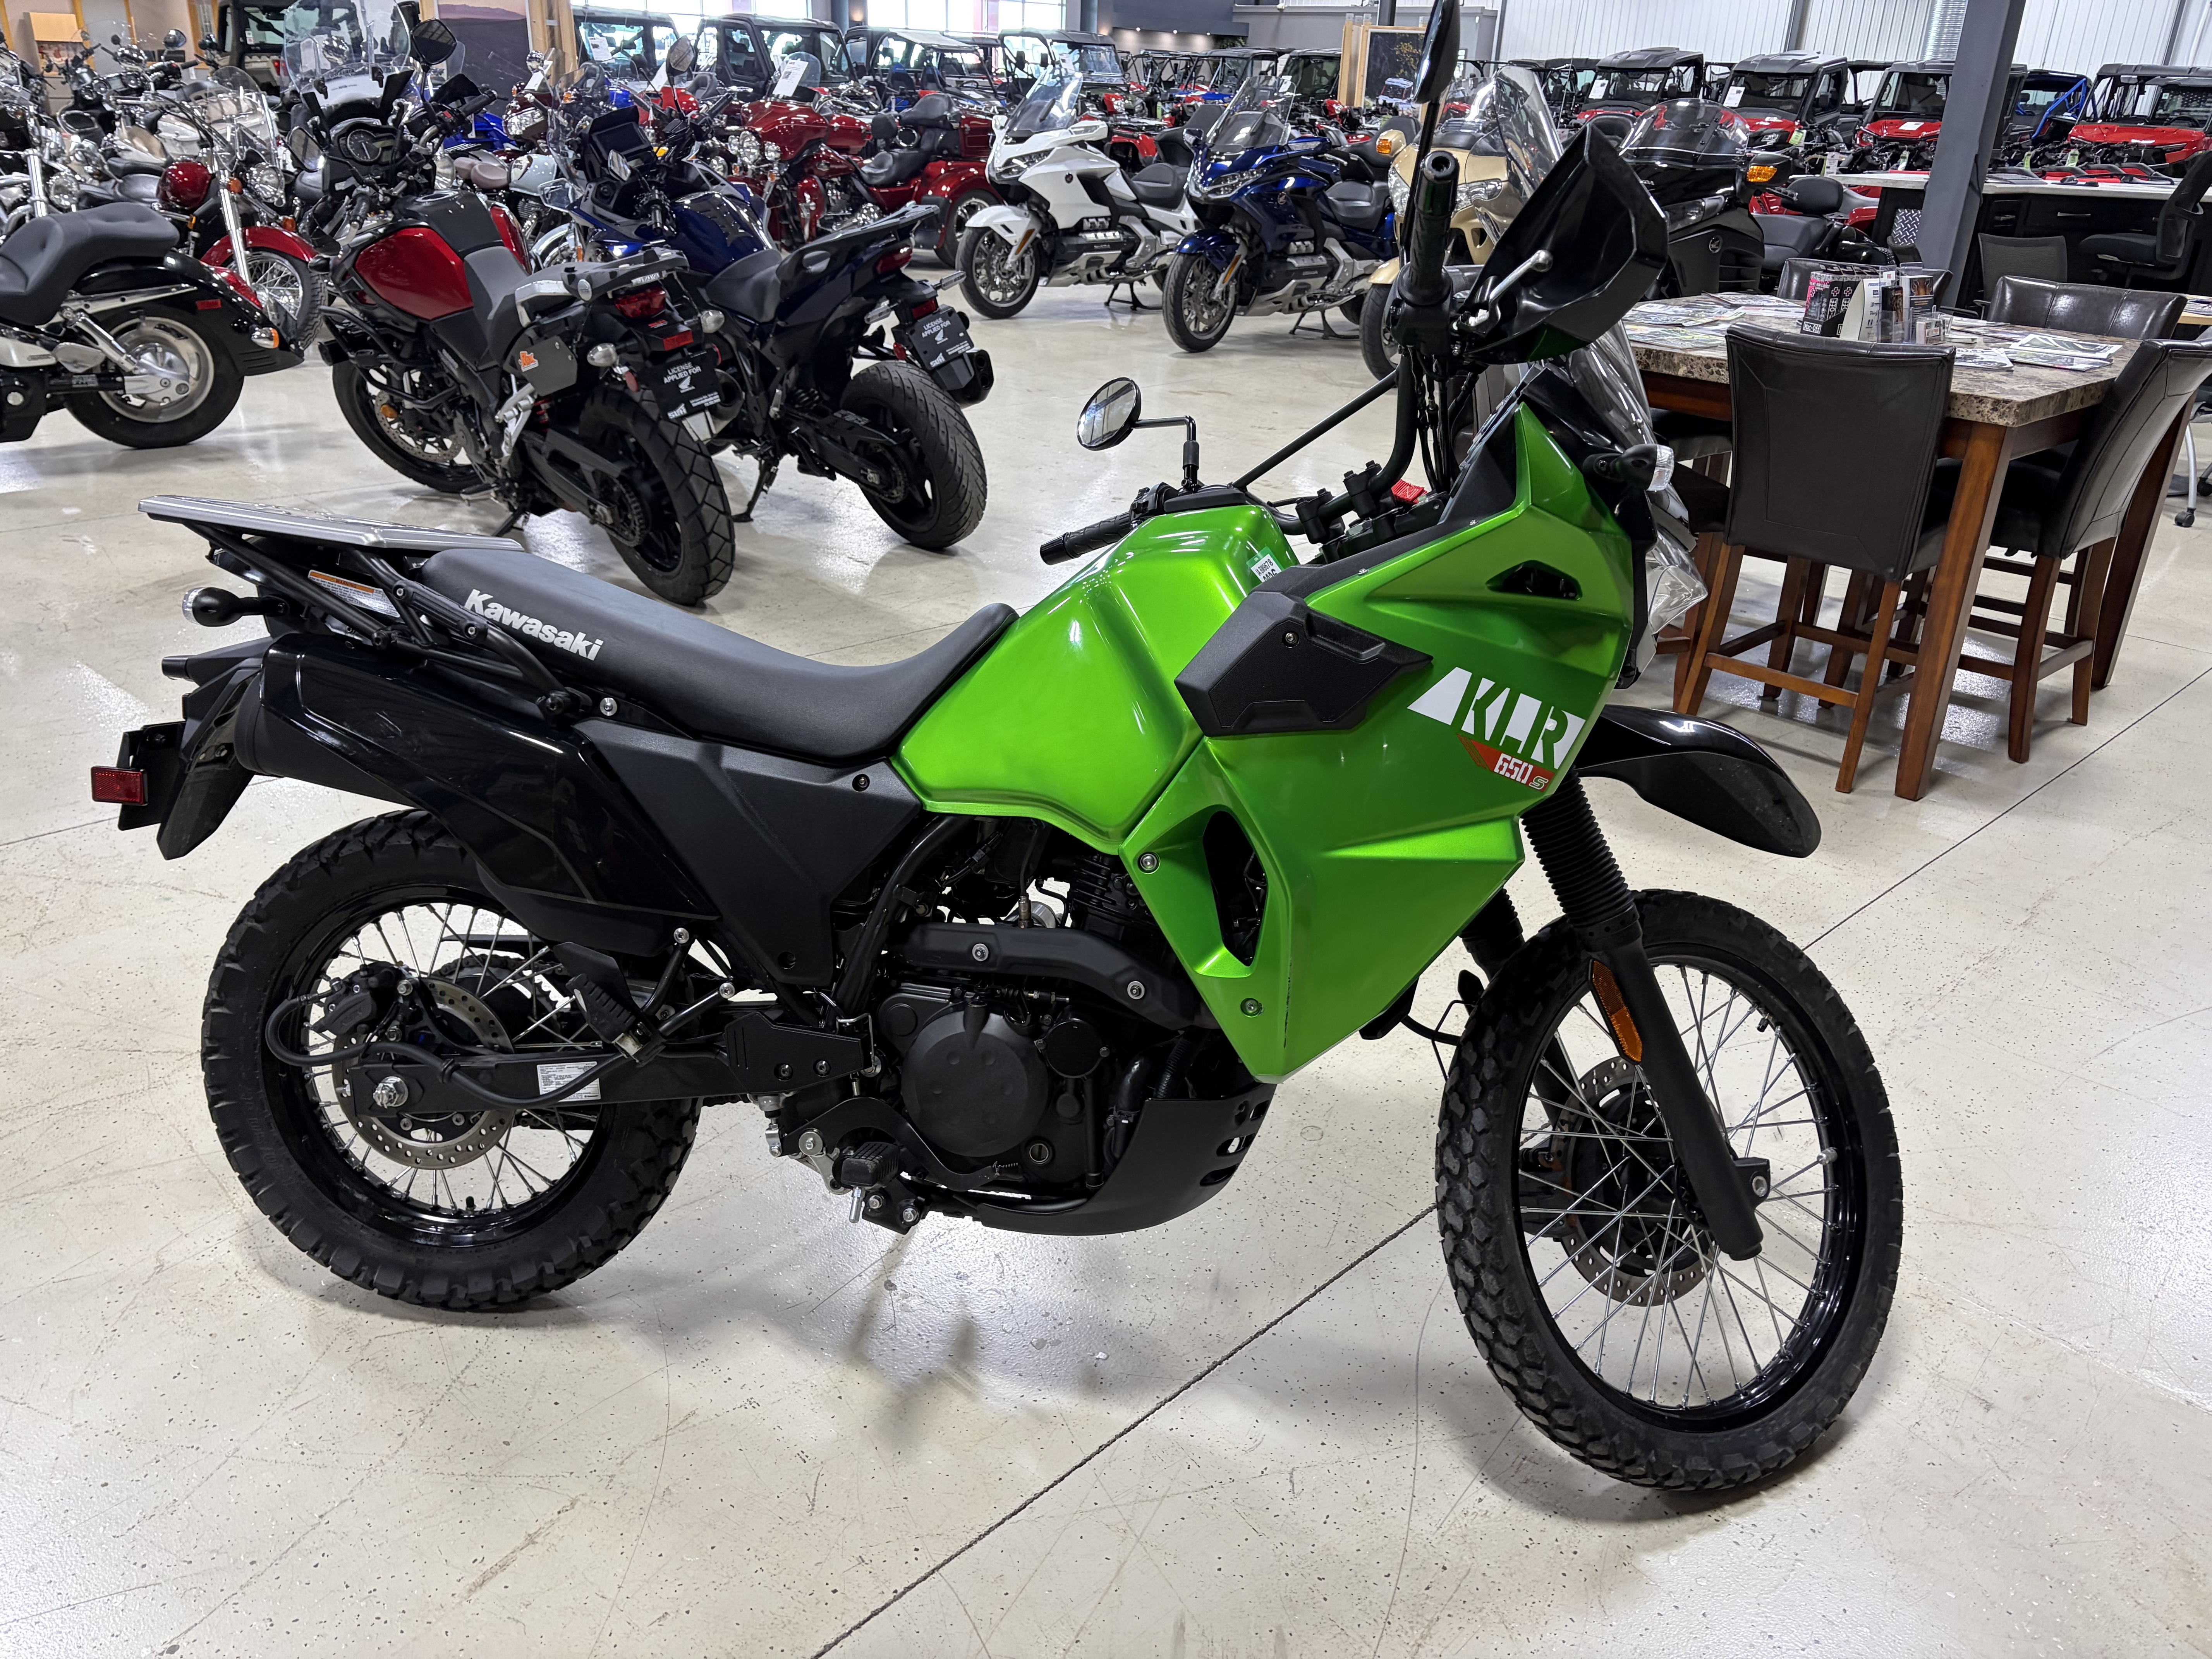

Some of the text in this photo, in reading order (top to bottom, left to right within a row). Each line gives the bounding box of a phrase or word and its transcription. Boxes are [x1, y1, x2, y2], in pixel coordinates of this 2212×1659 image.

[922, 320, 951, 338] APPLIED FOR
[923, 318, 943, 330] LICENSE
[663, 366, 702, 384] APPLIED FOR
[667, 362, 693, 375] LICENSE
[464, 589, 604, 661] Kawasaki
[1444, 667, 1576, 769] KLR
[1494, 753, 1534, 784] 650
